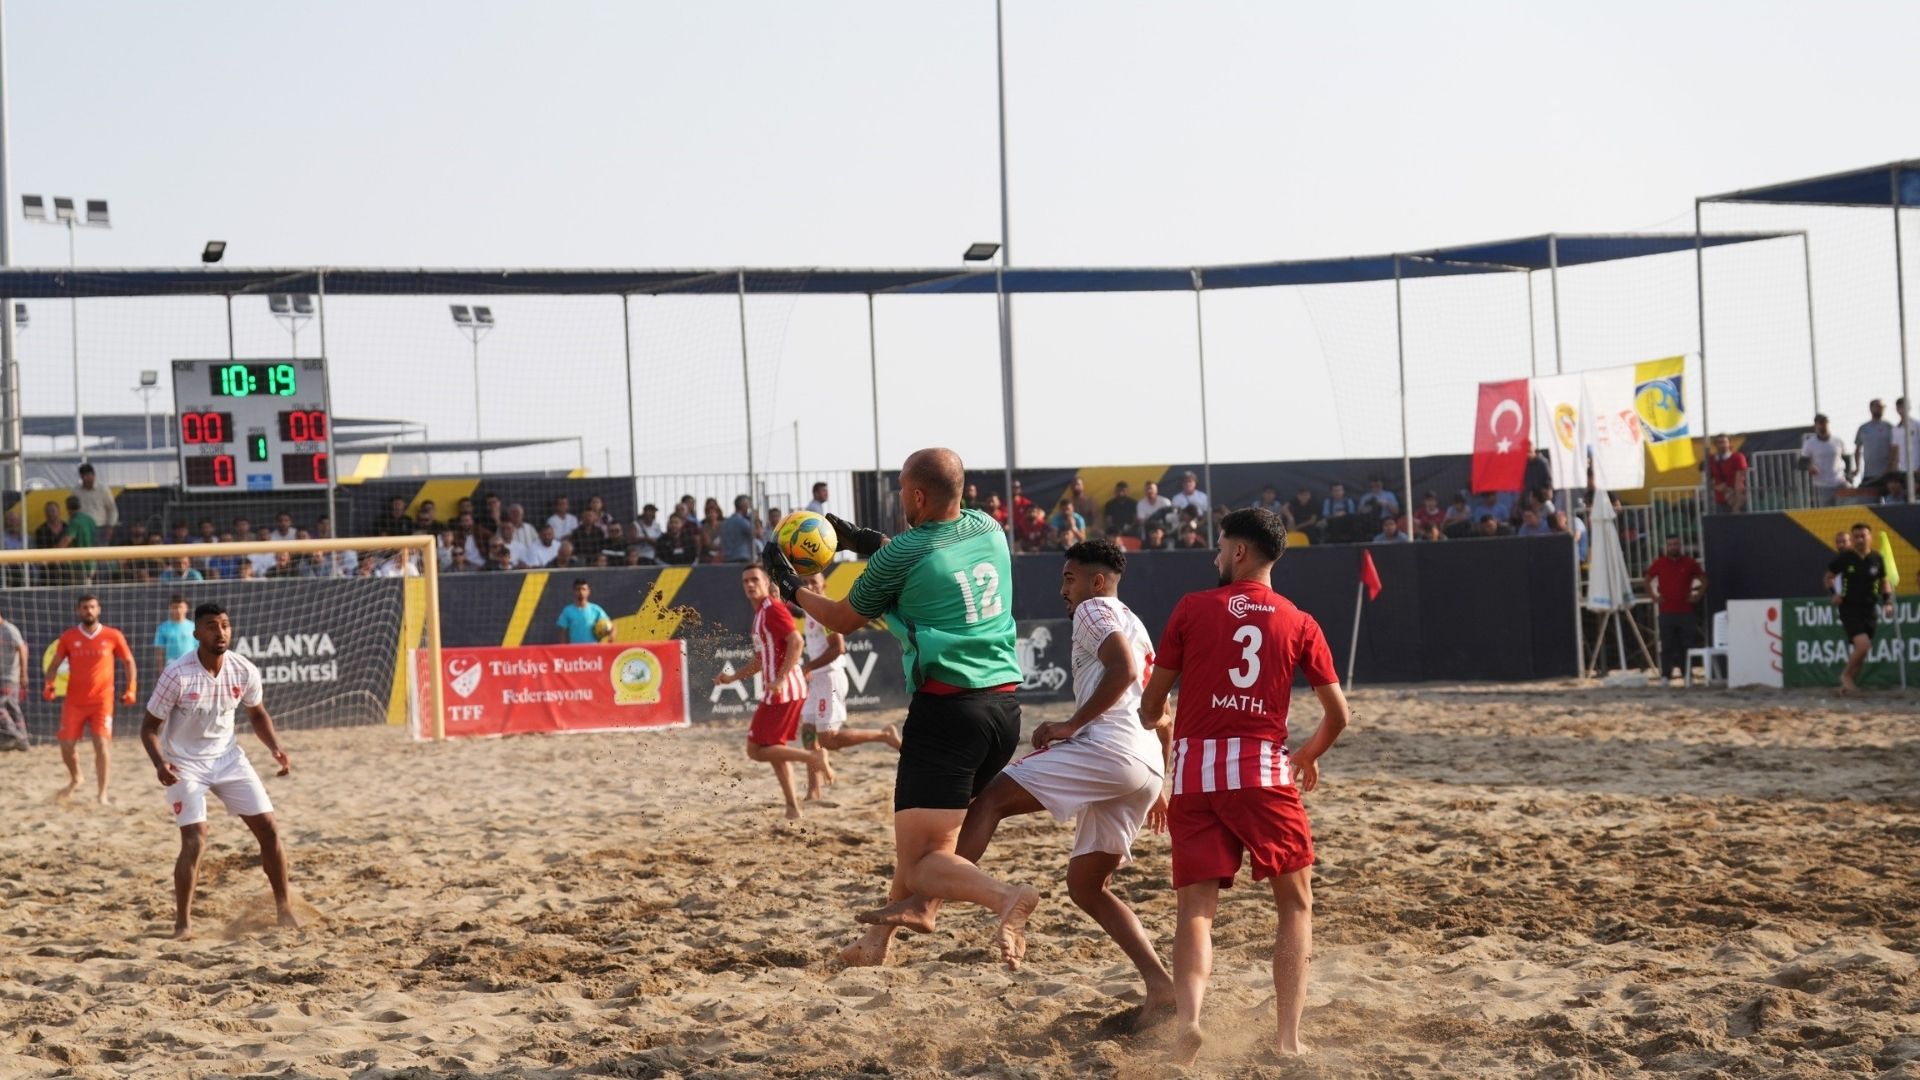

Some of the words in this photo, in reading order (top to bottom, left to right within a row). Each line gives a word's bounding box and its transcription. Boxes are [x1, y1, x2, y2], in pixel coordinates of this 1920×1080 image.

[221, 364, 296, 397] 10:19
[182, 412, 222, 444] 00
[258, 438, 266, 459] 1
[213, 454, 234, 487] 0
[953, 562, 1002, 624] 12
[1795, 602, 1832, 627] TÜM
[234, 633, 336, 658] ALANYA
[1228, 624, 1263, 689] 3
[488, 660, 548, 678] Türkiye
[553, 656, 603, 673] Futbol
[502, 688, 593, 705] Federasyonu
[1211, 693, 1267, 716] MATH.
[448, 704, 484, 721] TFF
